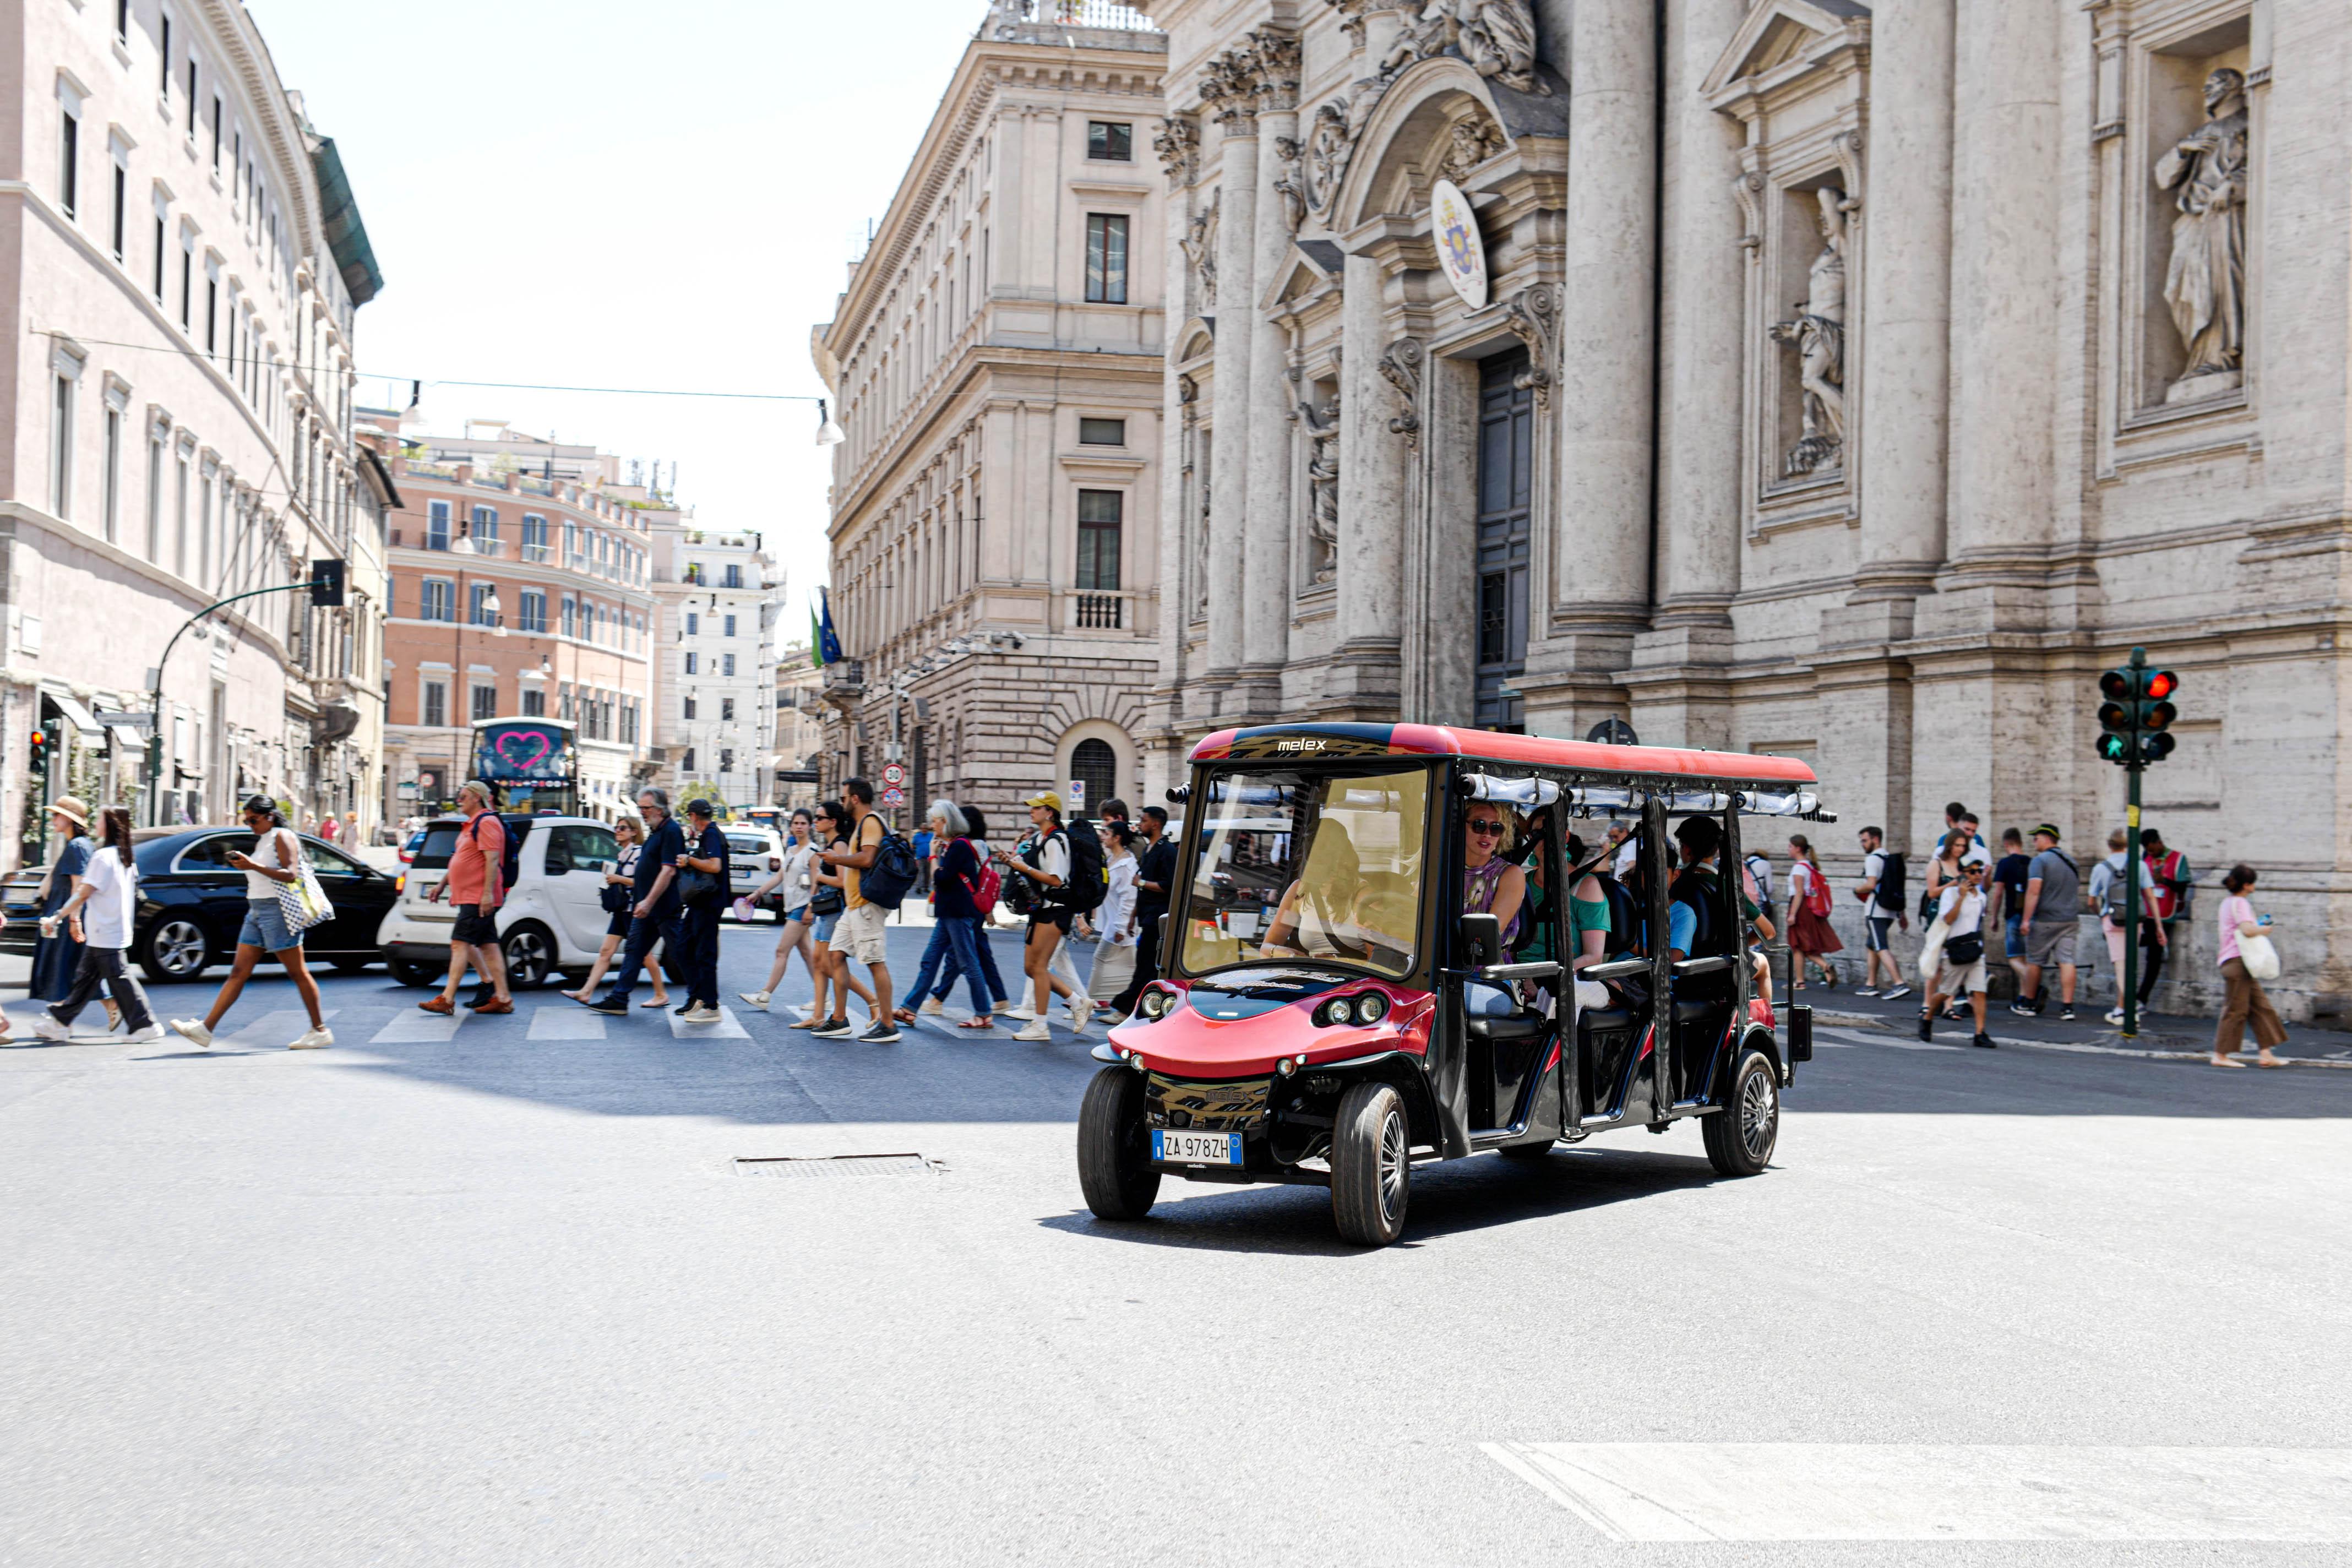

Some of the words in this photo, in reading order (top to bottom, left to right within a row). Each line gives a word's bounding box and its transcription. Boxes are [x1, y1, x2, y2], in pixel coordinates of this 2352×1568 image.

[1278, 738, 1327, 751] melex
[1165, 1137, 1180, 1156] ZA
[1186, 1138, 1228, 1158] 978ZH
